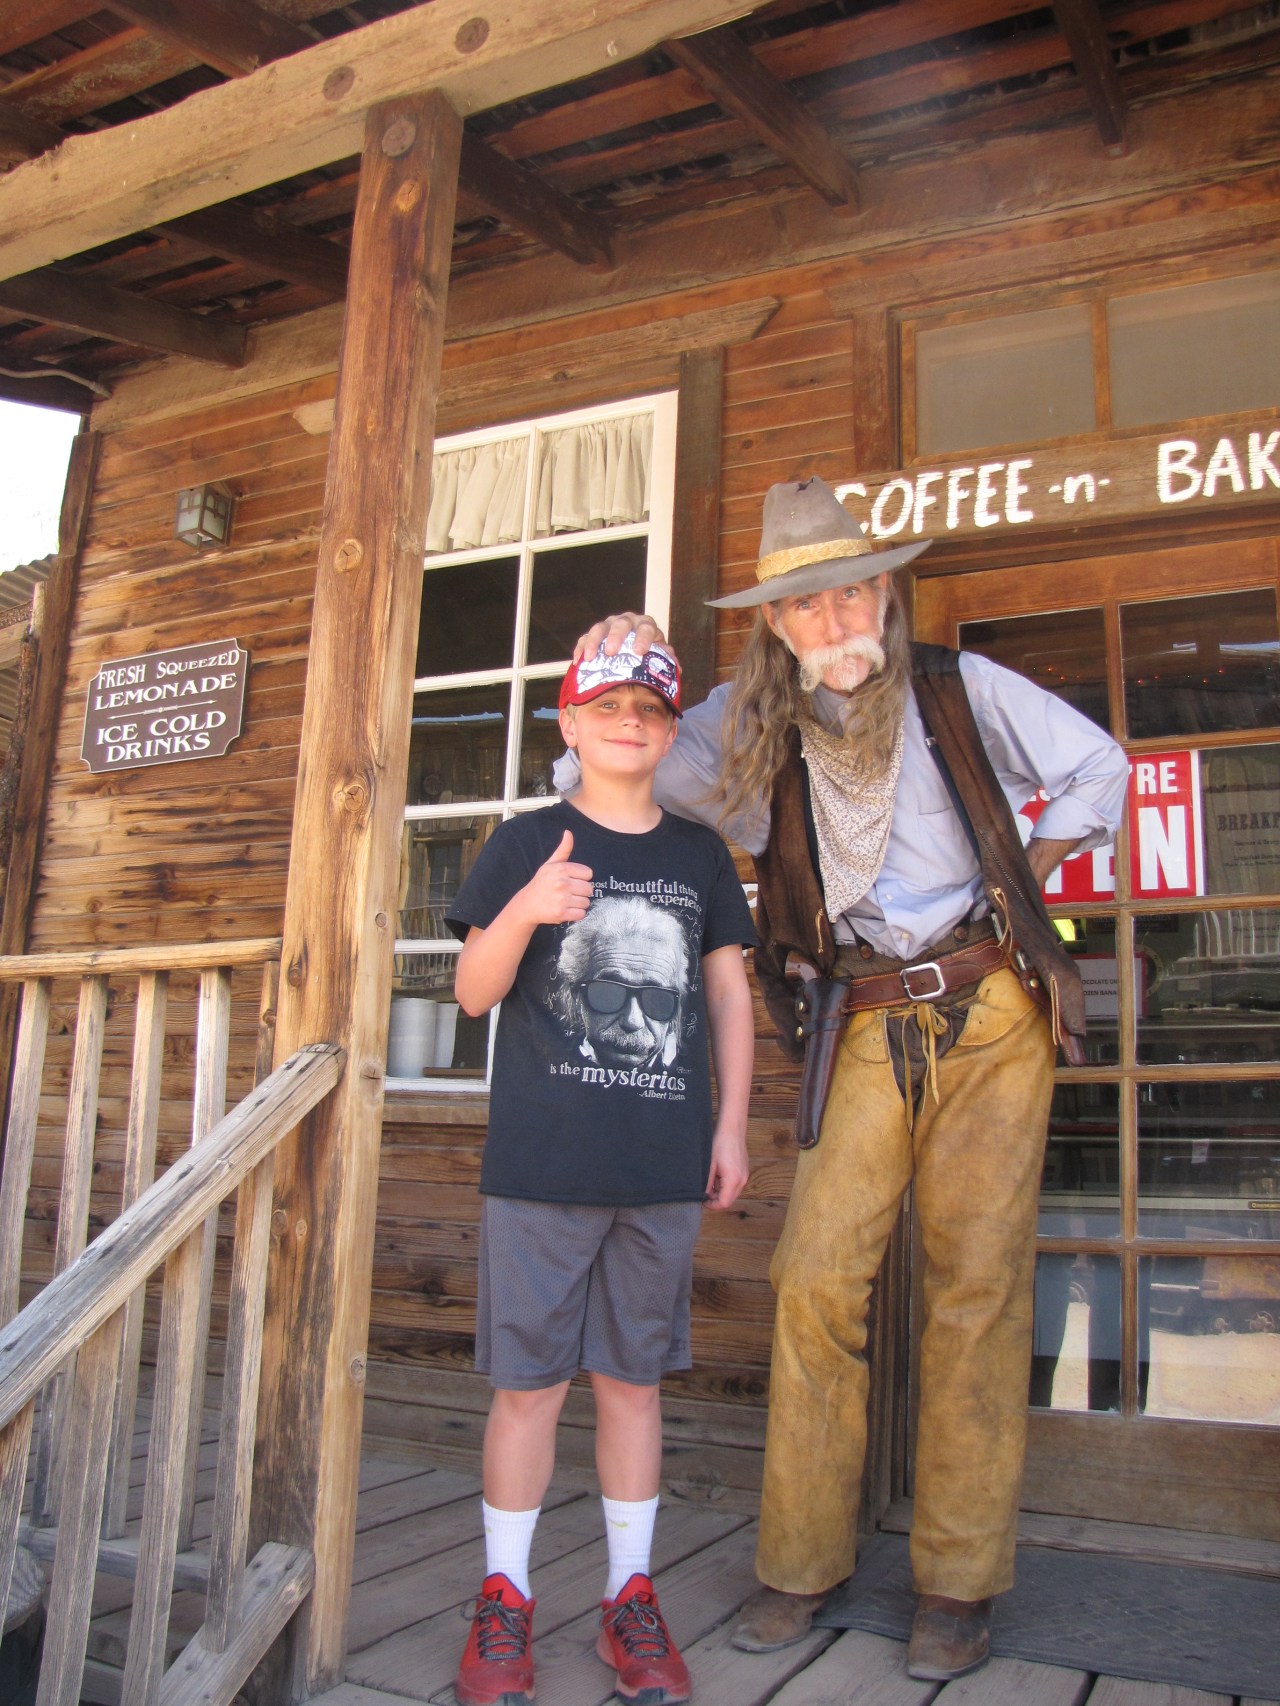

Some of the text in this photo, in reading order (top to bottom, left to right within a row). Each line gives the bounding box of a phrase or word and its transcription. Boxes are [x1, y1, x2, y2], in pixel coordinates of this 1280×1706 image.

[97, 650, 240, 690] FRESH SQUEEZED
[94, 673, 237, 710] LEMONADE
[96, 711, 227, 745] ICE COLD
[106, 732, 211, 763] DRINKS
[609, 876, 678, 894] beautiful
[679, 884, 698, 901] thing
[550, 1063, 557, 1074] is
[560, 1062, 580, 1075] the
